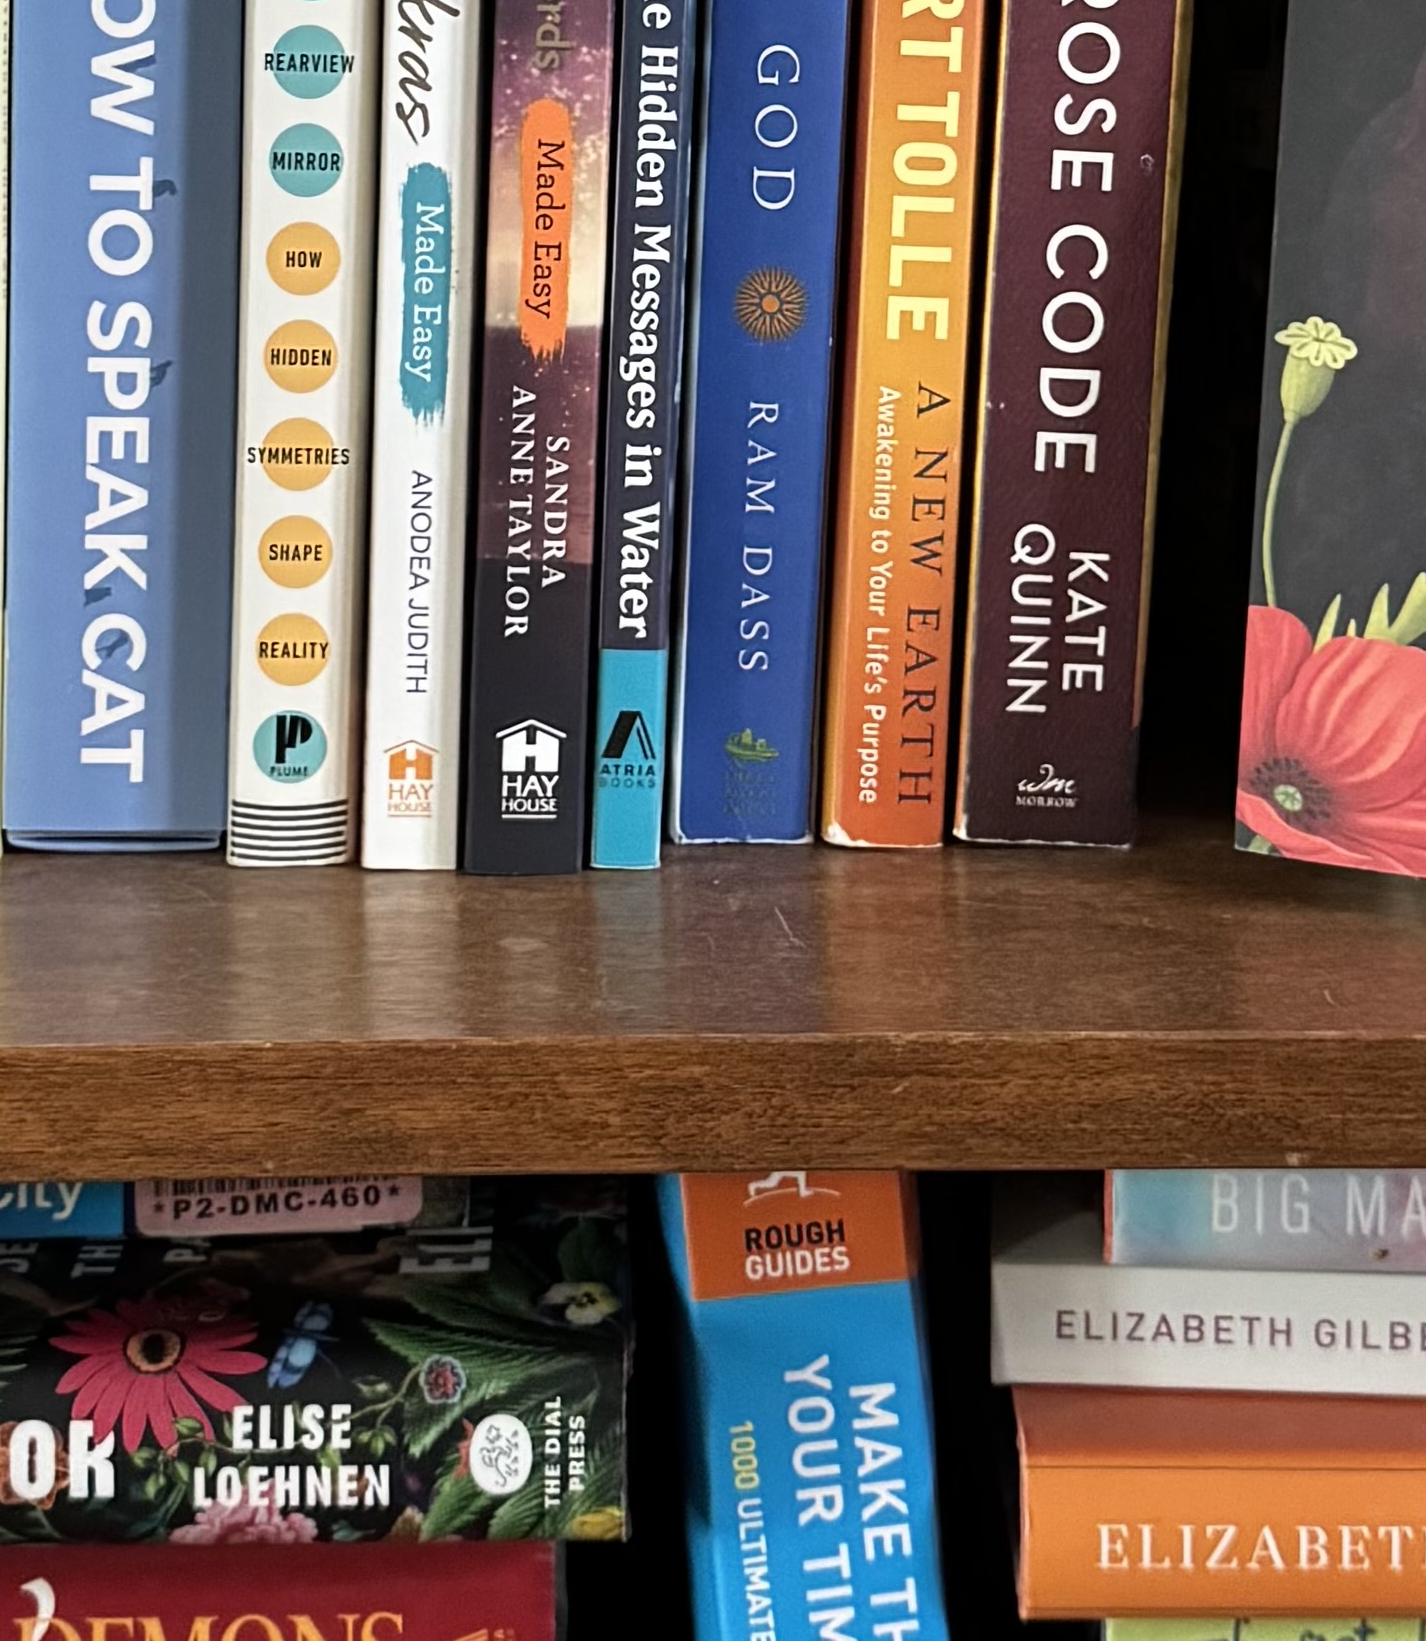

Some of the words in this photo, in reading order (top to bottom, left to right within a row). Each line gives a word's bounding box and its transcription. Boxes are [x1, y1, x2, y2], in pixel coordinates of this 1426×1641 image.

[264, 53, 354, 74] REARVIEW
[272, 151, 341, 172] MIRROR
[634, 45, 678, 209] Hidden
[752, 44, 801, 210] GOD
[534, 139, 566, 231] Made
[886, 91, 961, 341] TOLLE
[285, 250, 323, 269] HOW
[414, 202, 445, 295] Made
[524, 241, 562, 320] Easy
[269, 348, 332, 367] HIDDEN
[404, 303, 442, 382] Easy
[619, 225, 670, 429] Messages
[1033, 224, 1109, 474] CODE
[511, 385, 538, 485] ANNE
[917, 381, 951, 419] A
[247, 446, 350, 465] SYMMETRIES
[624, 445, 662, 488] in
[744, 401, 780, 513] RAM
[867, 386, 902, 521] Awakening
[408, 470, 433, 590] ANODEA
[541, 436, 571, 588] SANDRA
[870, 529, 888, 553] to
[909, 447, 948, 576] NEW
[268, 543, 323, 562] SHAPE
[504, 499, 533, 638] TAYLOR
[618, 502, 661, 640] Water
[868, 561, 893, 617] Your
[405, 598, 430, 694] JUDITH
[738, 545, 773, 672] DASS
[1005, 523, 1056, 714] QUINN
[1061, 551, 1111, 693] KATE
[258, 641, 330, 660] REALITY
[865, 627, 890, 694] Life's
[897, 606, 941, 805] EARTH
[502, 775, 560, 797] HAY
[857, 702, 887, 803] Purpose
[502, 798, 558, 812] HOUSE
[744, 1220, 845, 1253] ROUGH
[744, 1247, 849, 1281] GUIDES
[1055, 1309, 1293, 1348] ELIZABETH
[232, 1404, 352, 1451] ELISE
[545, 1397, 560, 1462] DIAL
[569, 1415, 585, 1492] PRESS
[192, 1464, 390, 1509] LOEHNEN
[545, 1467, 560, 1509] THE
